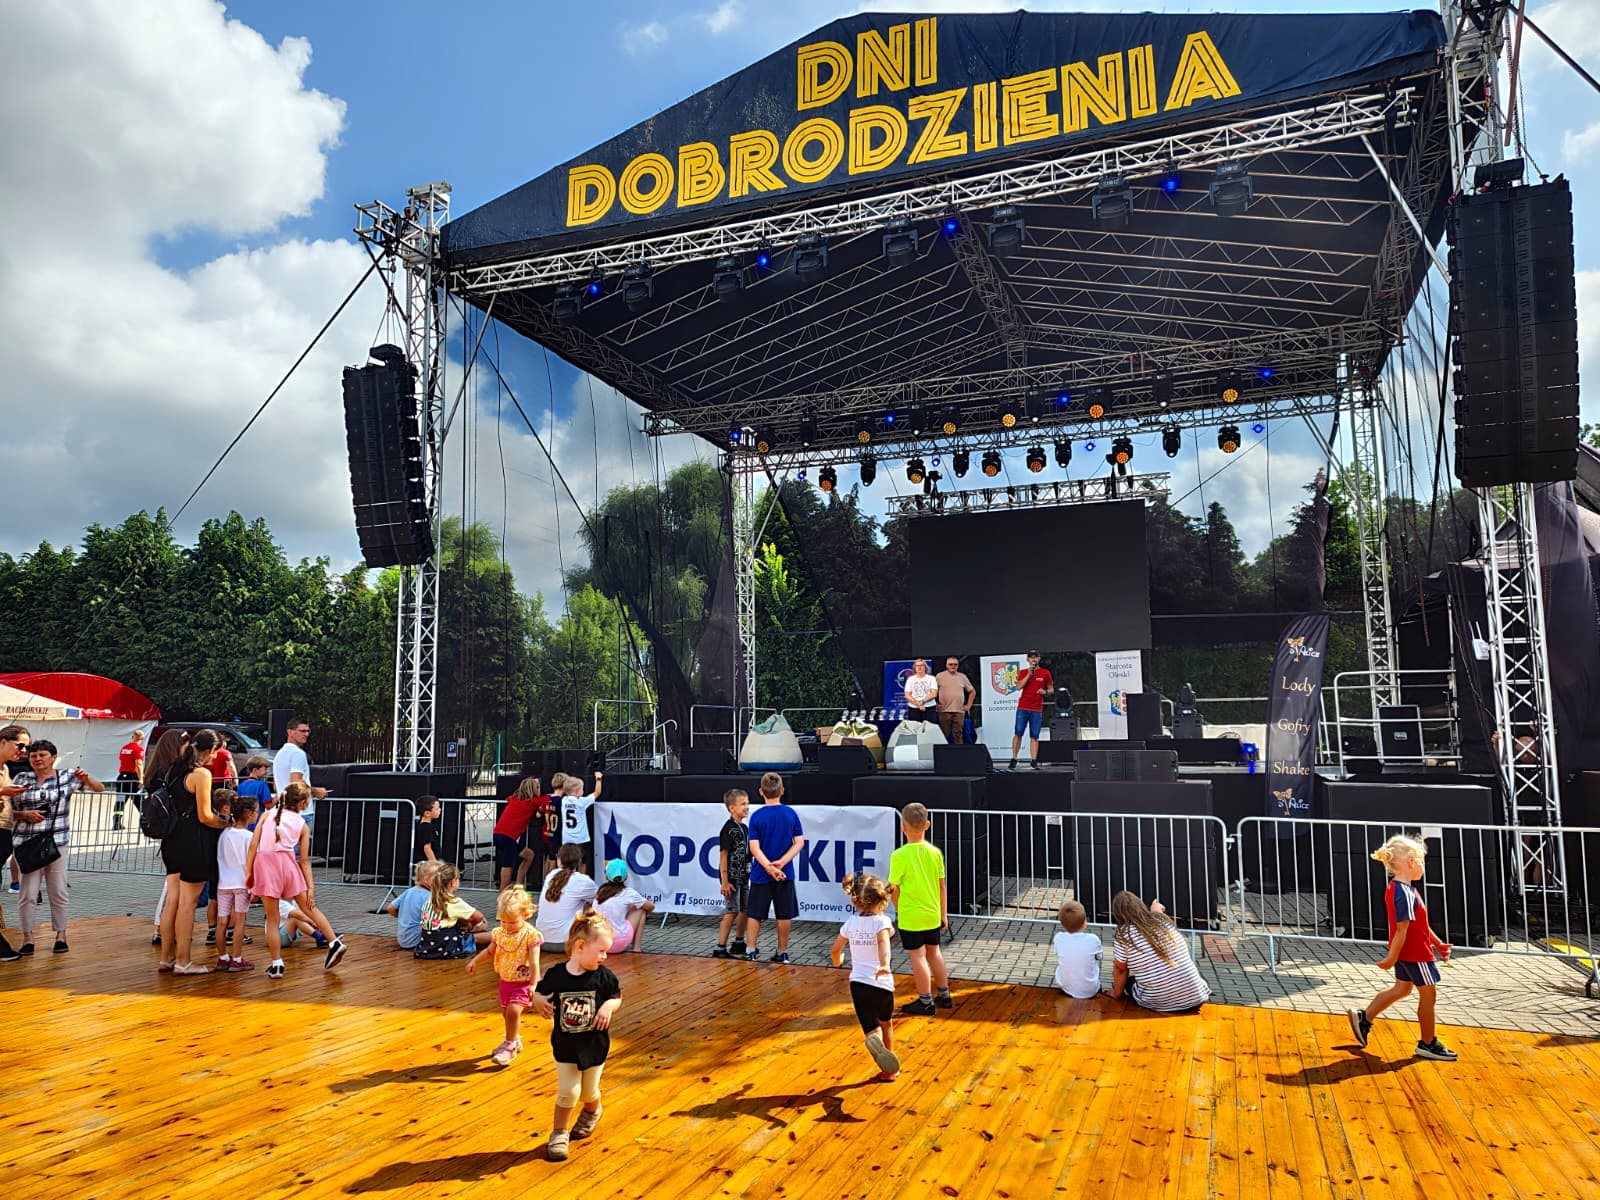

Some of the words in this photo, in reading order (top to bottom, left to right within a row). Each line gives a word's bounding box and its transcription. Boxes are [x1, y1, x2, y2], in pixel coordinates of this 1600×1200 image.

[797, 17, 937, 111] DNI
[566, 31, 1241, 227] DOBRODZIENIA
[1282, 676, 1316, 697] Lody
[1277, 718, 1311, 736] Gofry
[1273, 760, 1311, 776] Shake
[545, 813, 559, 832] 10
[565, 809, 578, 829] 5
[626, 833, 877, 885] OPOKIE
[799, 901, 843, 912] Sportowe
